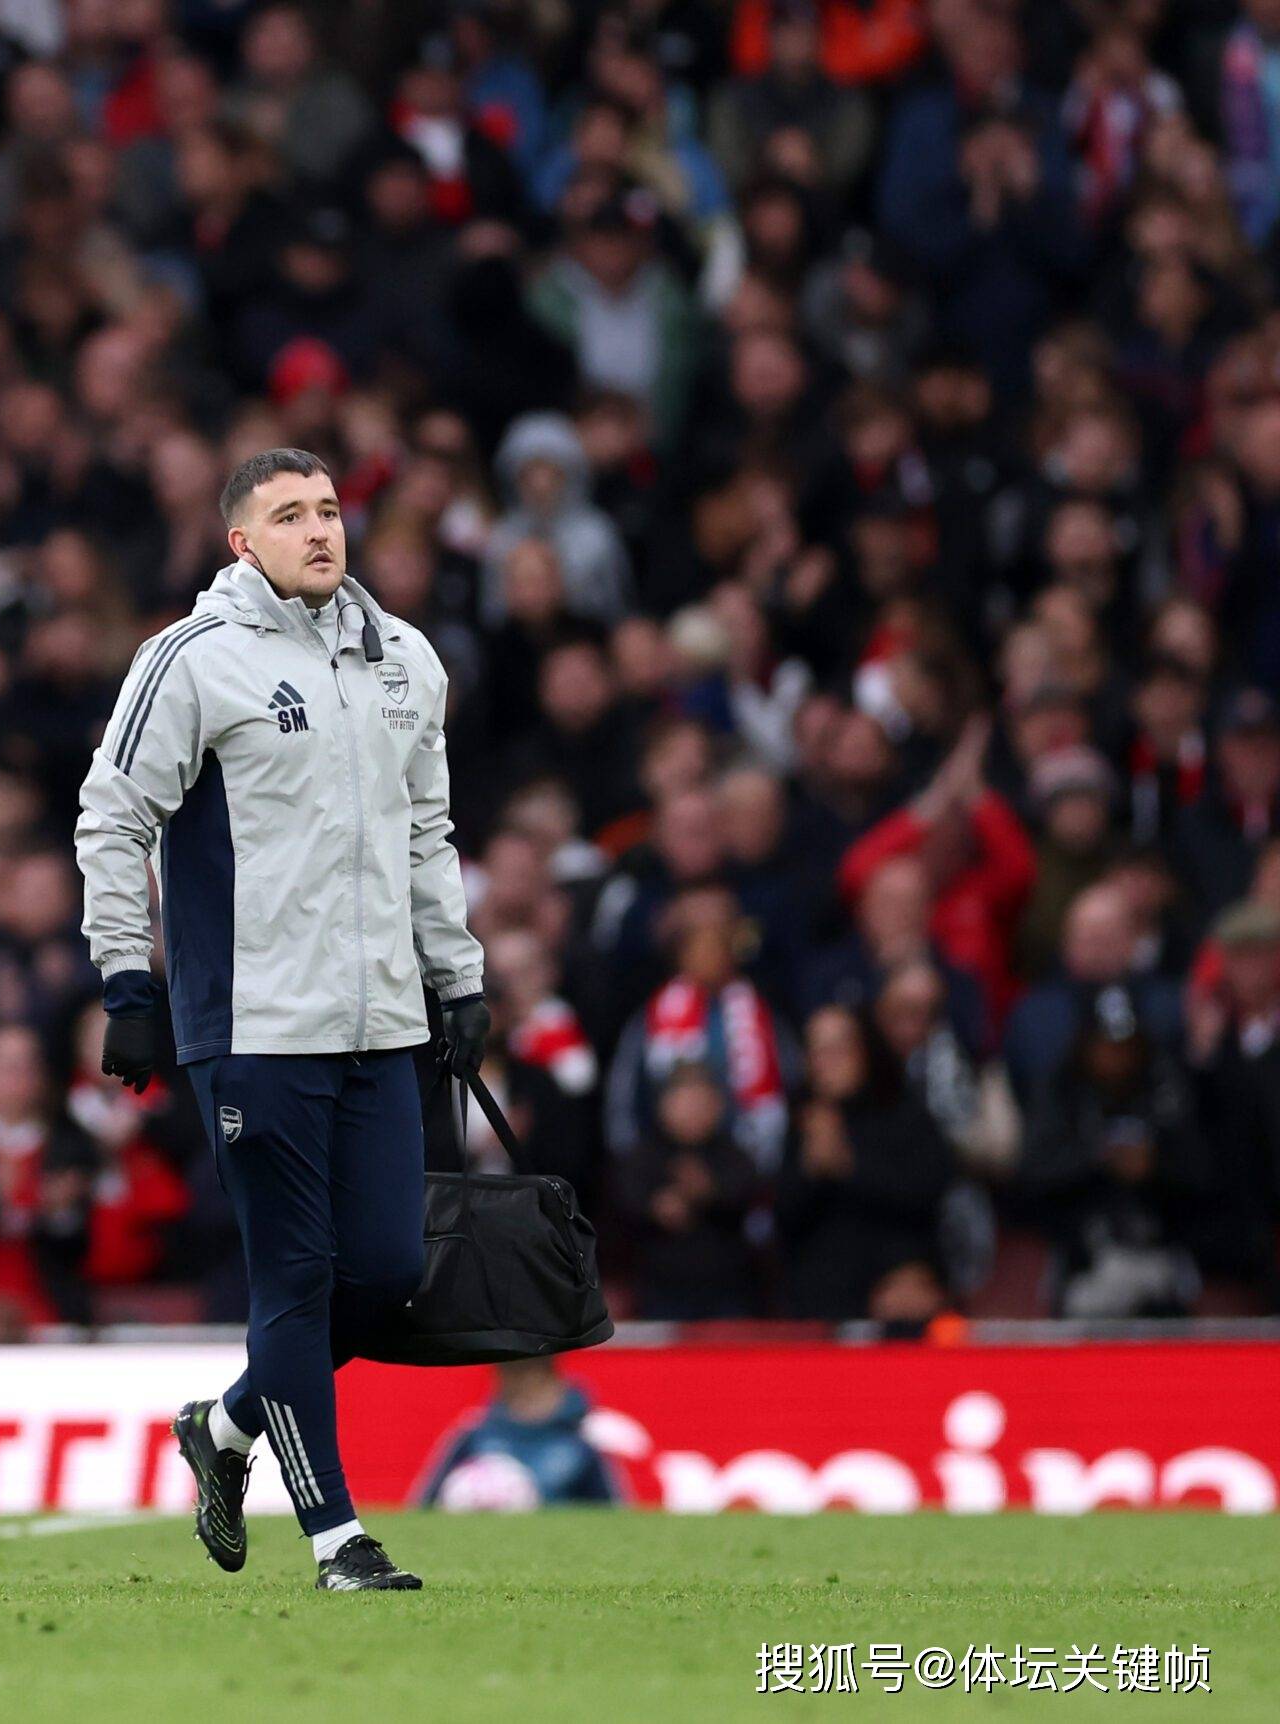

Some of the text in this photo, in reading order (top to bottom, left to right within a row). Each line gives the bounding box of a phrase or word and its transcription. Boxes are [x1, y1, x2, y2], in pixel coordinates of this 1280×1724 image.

[277, 706, 309, 734] SM
[381, 707, 419, 720] Emirates
[389, 720, 415, 731] FLY BETTER
